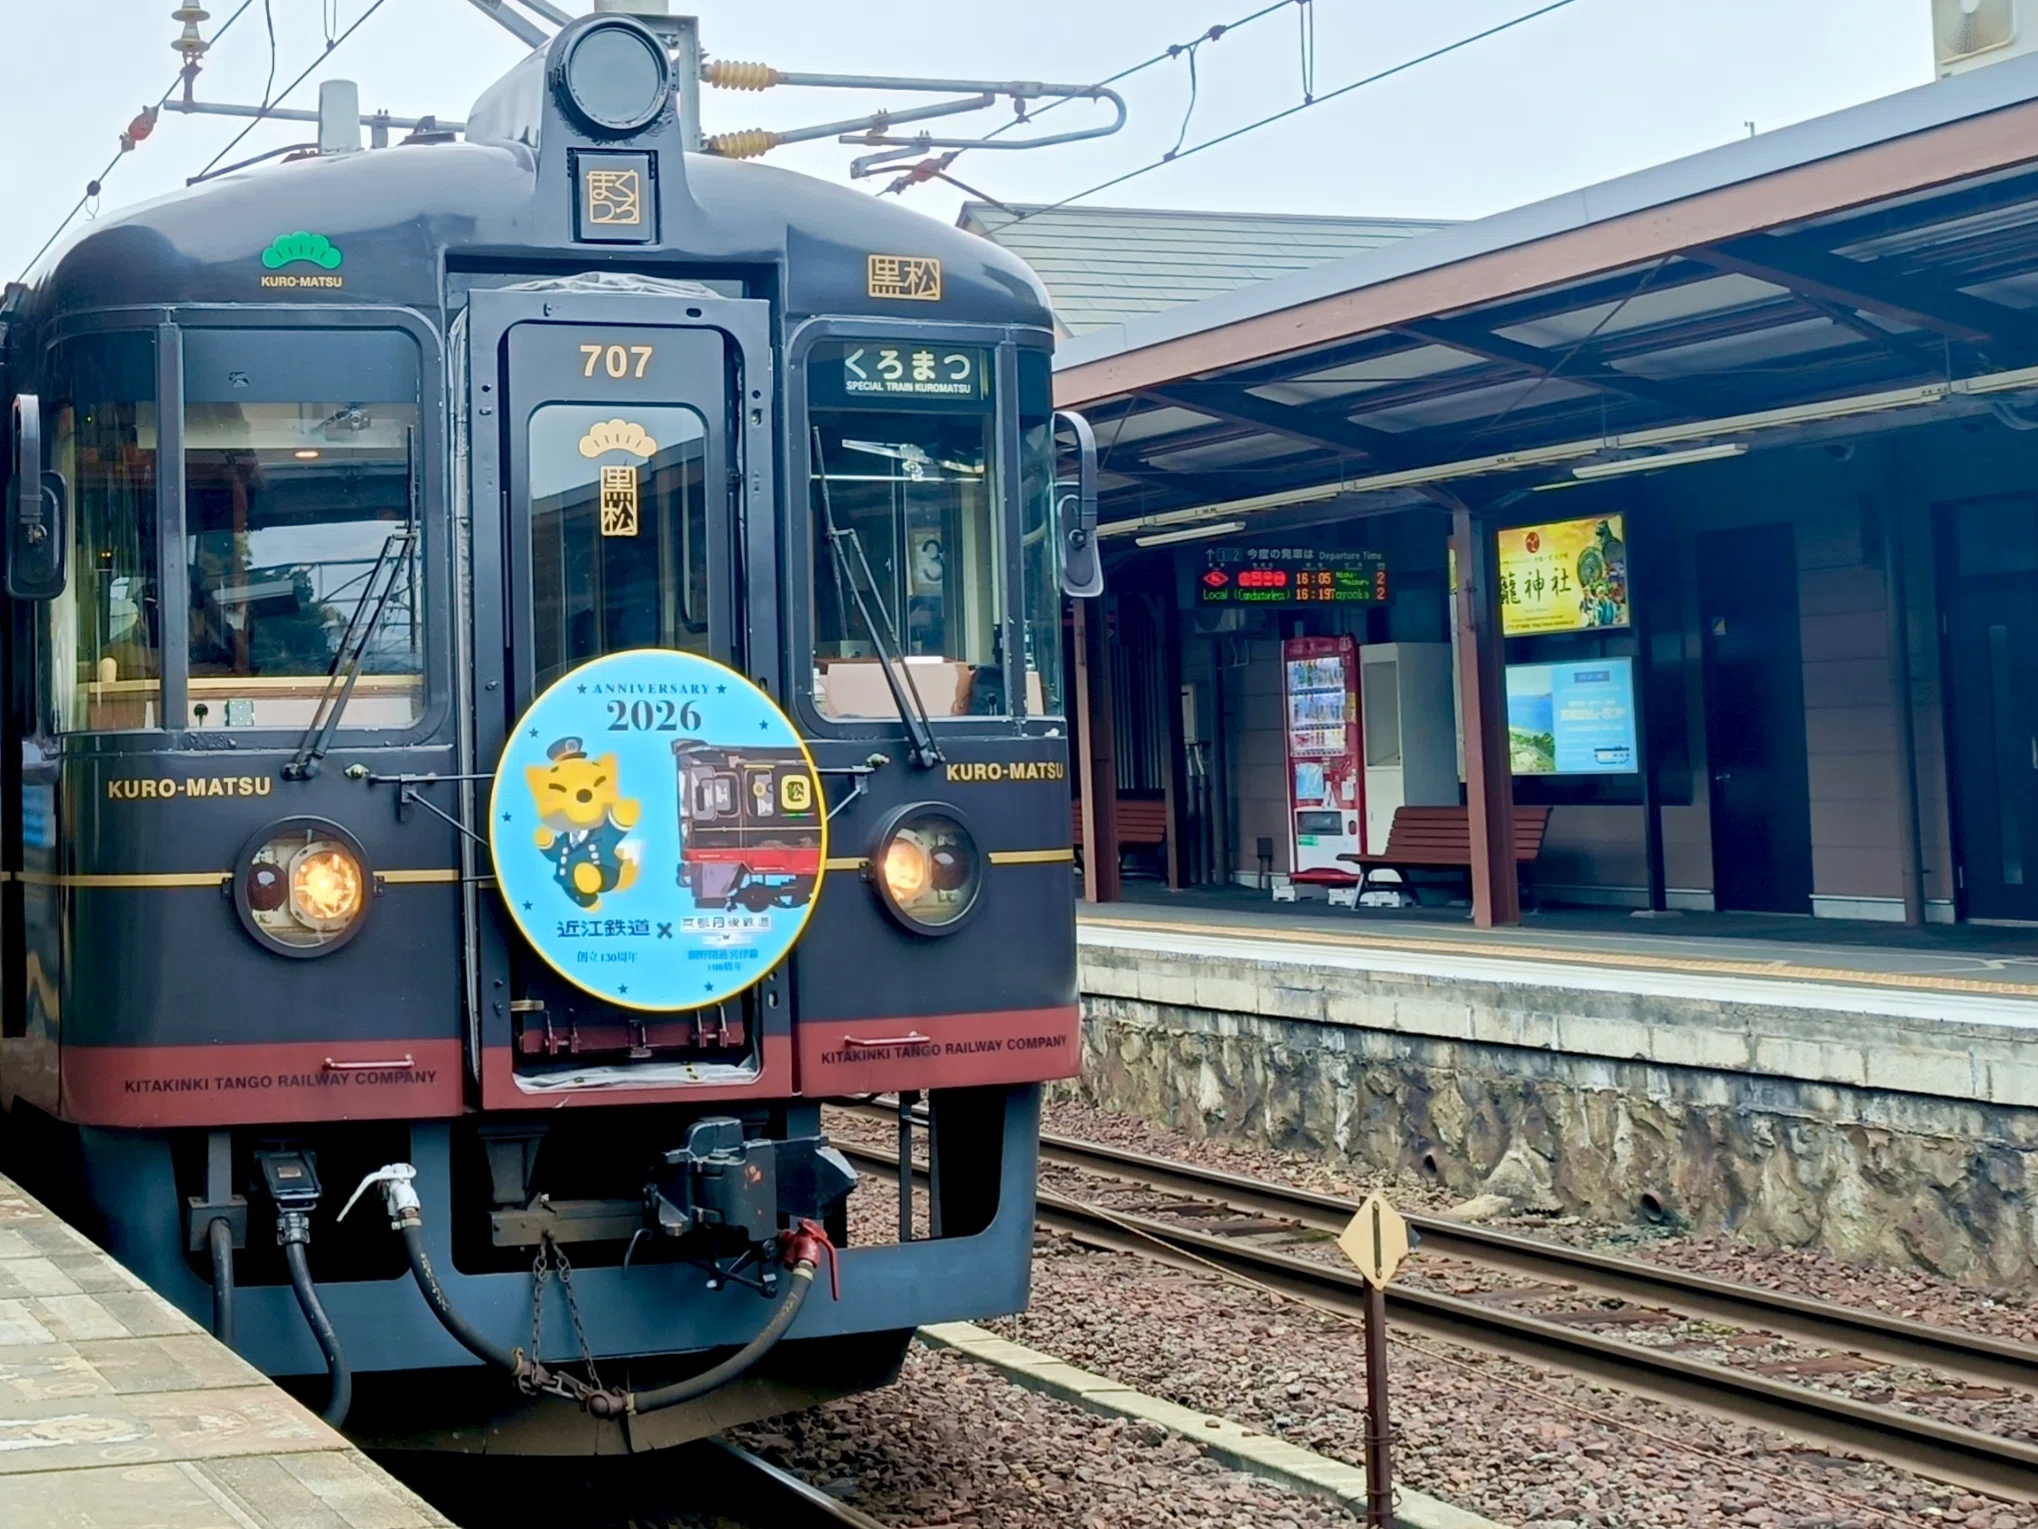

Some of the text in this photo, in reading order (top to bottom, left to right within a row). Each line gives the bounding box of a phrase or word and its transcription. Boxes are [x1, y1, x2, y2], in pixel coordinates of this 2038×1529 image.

[261, 276, 343, 287] KURO-MATSU
[868, 255, 941, 300] 黒松
[579, 345, 653, 378] 707
[845, 348, 971, 381] くろまつ
[846, 380, 971, 394] SPECIAL TRAIN KUROMATSU
[601, 466, 638, 536] 黒松
[1247, 548, 1314, 560] 今度の発車は
[1319, 551, 1383, 562] Departure Time
[1296, 572, 1332, 585] 16:05
[1376, 571, 1386, 585] 2
[1203, 588, 1228, 600] Local
[1296, 588, 1332, 601] 16:19
[1376, 587, 1386, 600] 2
[593, 683, 710, 694] ANNIVERSARY
[606, 700, 702, 731] 2026
[946, 762, 1064, 781] KURO-MATSU
[108, 777, 271, 799] KURO-MATSU
[557, 919, 650, 938] 近江鉄道
[821, 1034, 1067, 1064] KITAKINKI TANGO RAILWAY COMPANY
[125, 1070, 437, 1093] KITAKINKI TANGO RAILWAY COMPANY
